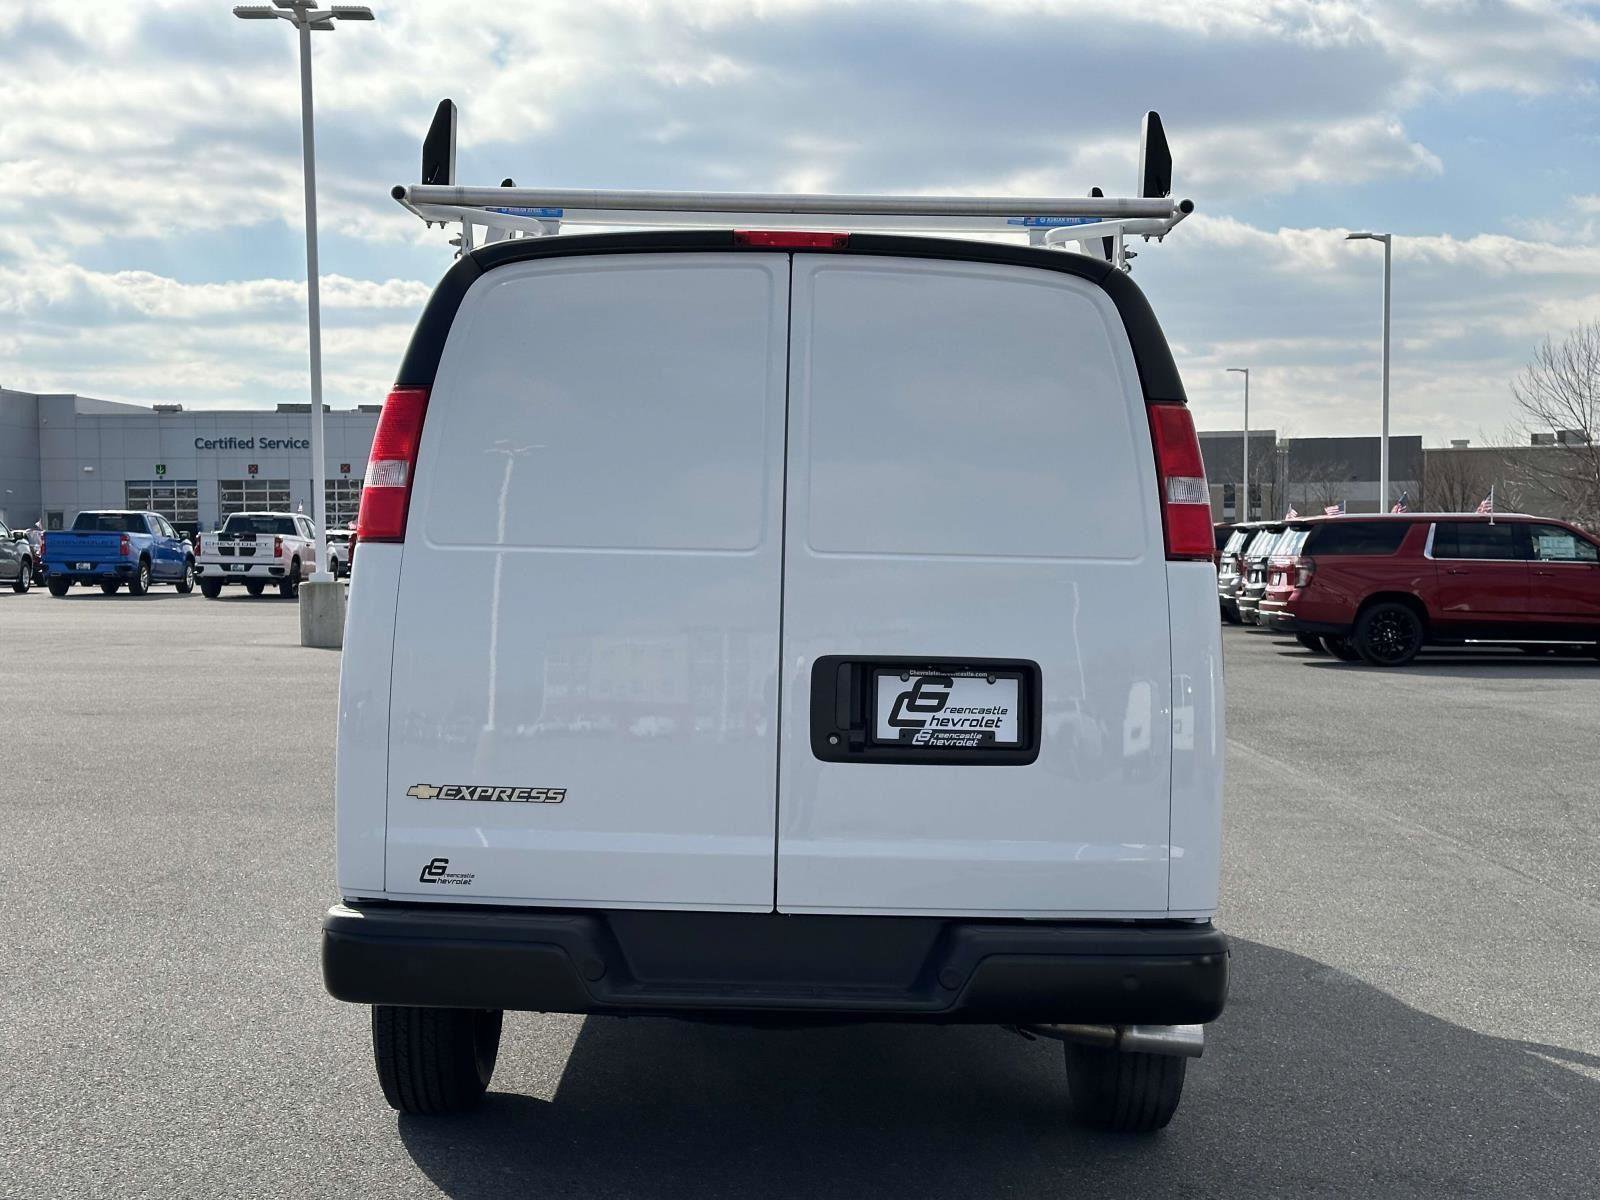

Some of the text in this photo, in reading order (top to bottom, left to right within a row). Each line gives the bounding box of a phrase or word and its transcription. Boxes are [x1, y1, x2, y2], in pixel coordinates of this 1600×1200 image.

[194, 436, 310, 450] Certified Service
[438, 785, 567, 803] EXPRESS
